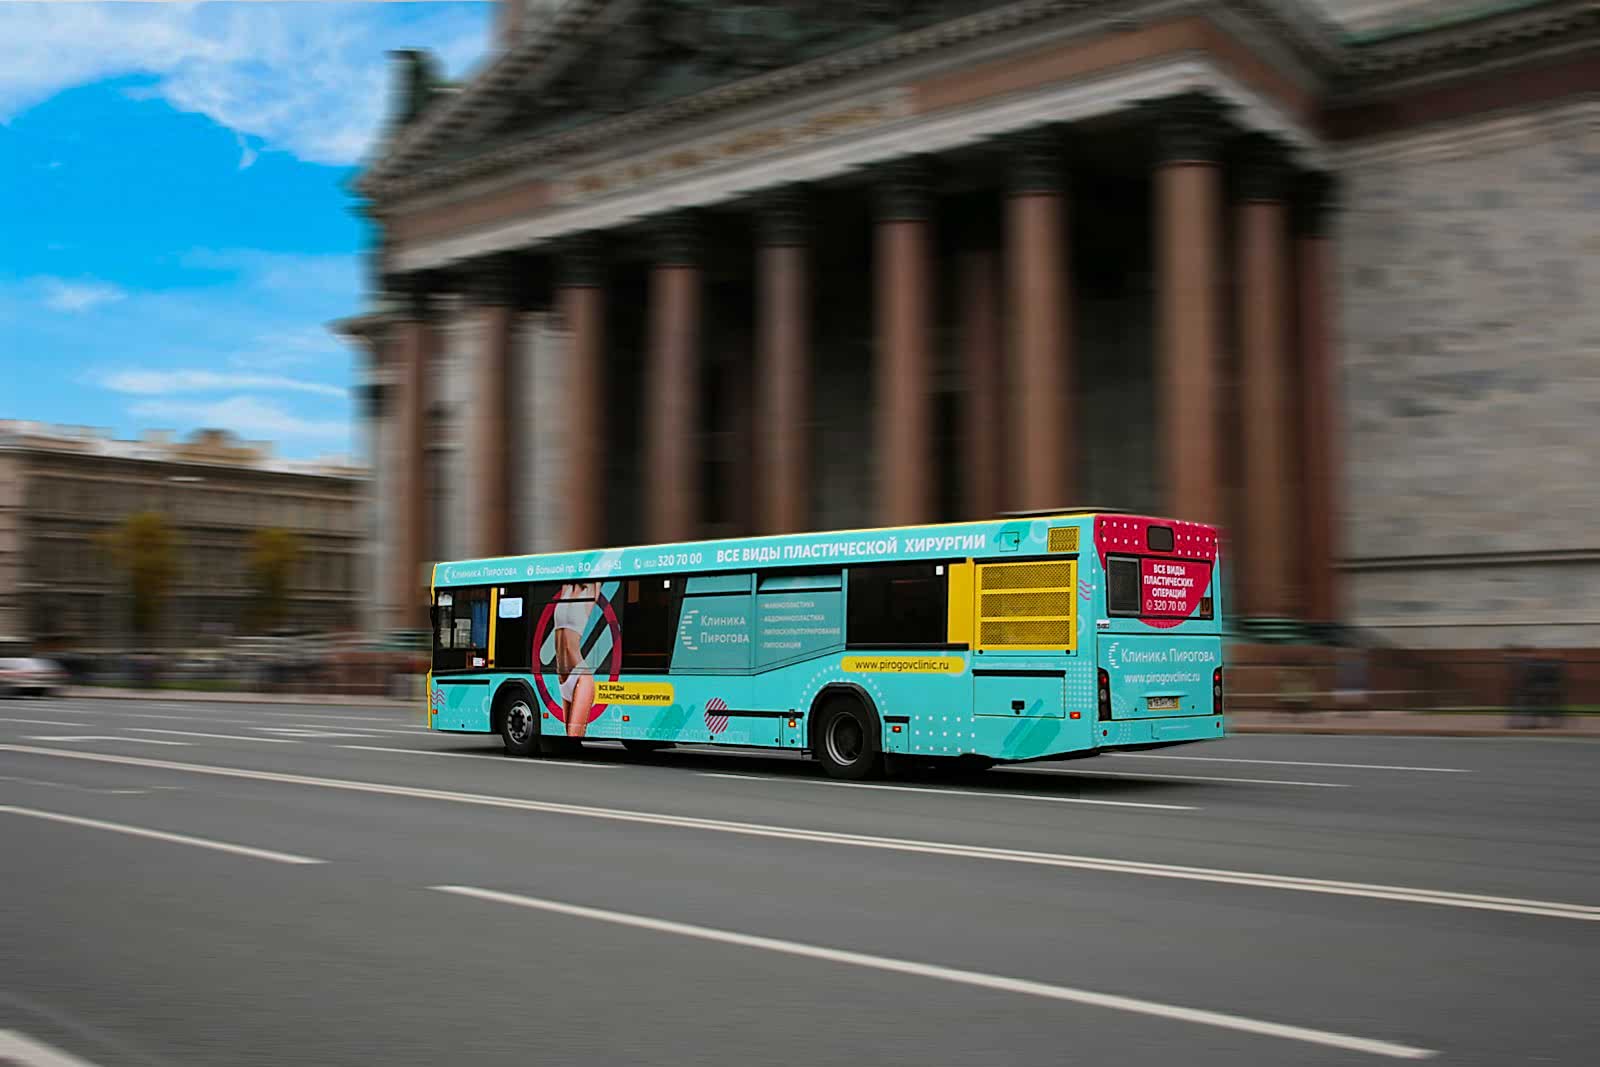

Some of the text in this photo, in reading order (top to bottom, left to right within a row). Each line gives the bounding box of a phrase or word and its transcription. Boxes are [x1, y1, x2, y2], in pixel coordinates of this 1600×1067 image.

[717, 534, 986, 563] ВСЕ ВИДЫ ПЛАСТИЧЕСКОЙ ХИРУРГИИ
[657, 554, 675, 567] 320
[676, 553, 688, 565] 70
[689, 552, 702, 564] 00
[1153, 564, 1186, 576] ВСЕ ВИДЫ
[1143, 575, 1194, 587] ПЛАСТИЧЕСКИХ
[1151, 587, 1187, 599] ОПЕРАЦИЙ
[1153, 600, 1187, 611] 320 70 00
[855, 658, 949, 672] www.pirogovclinic.ru
[1123, 671, 1200, 685] www.pirogovclinic.ru
[598, 692, 671, 701] ПЛАСТИЧЕСКОЙ ХИРУРГИИ
